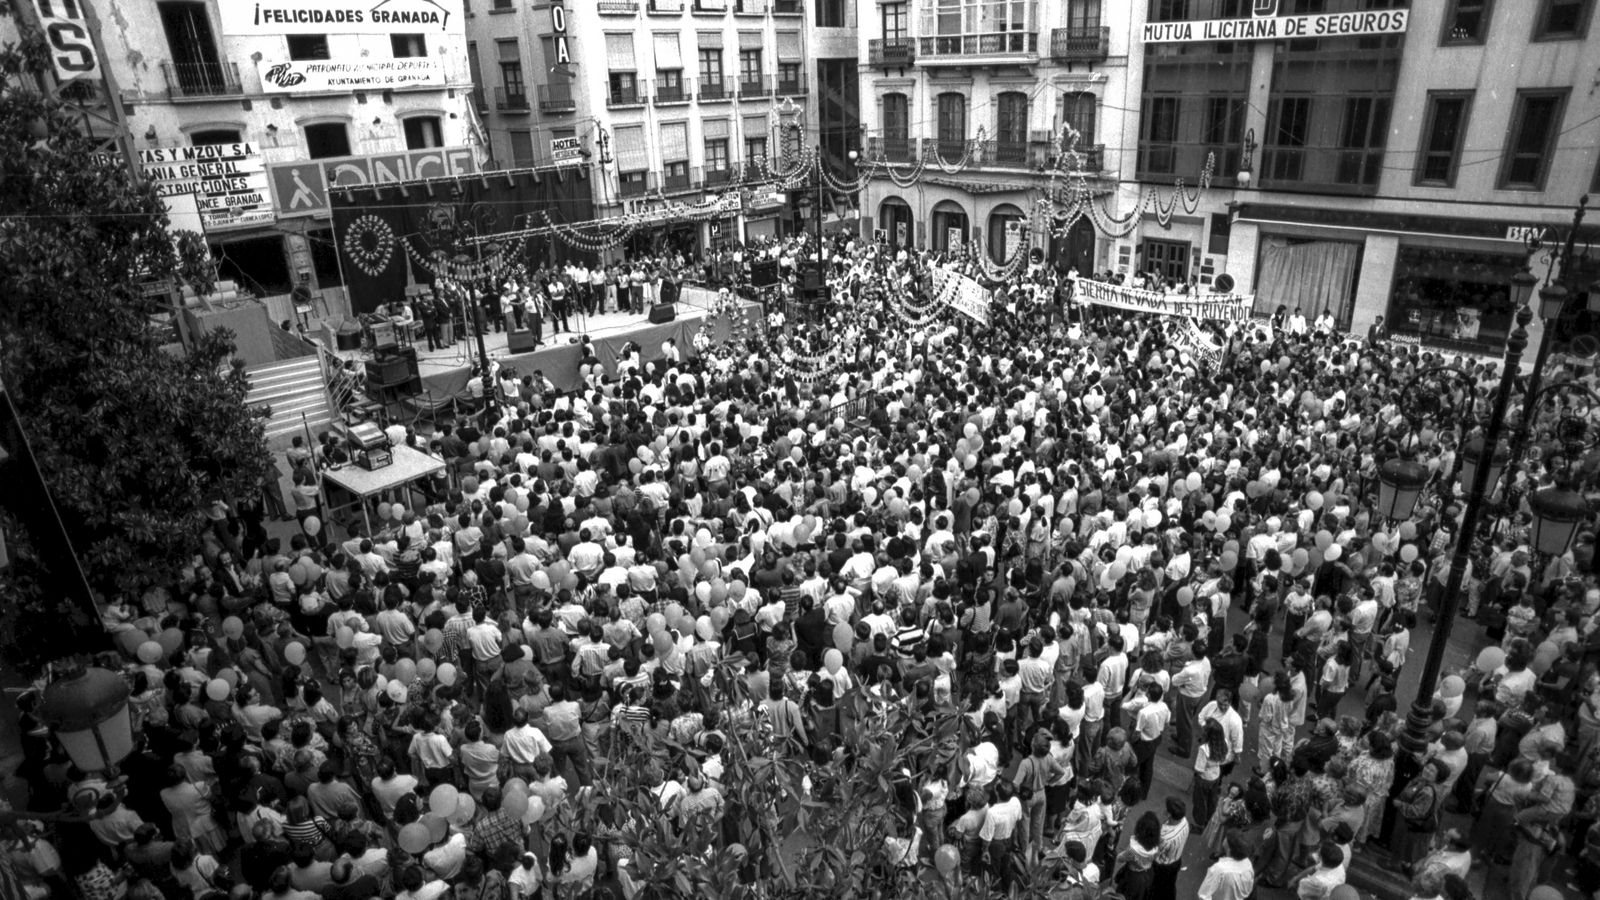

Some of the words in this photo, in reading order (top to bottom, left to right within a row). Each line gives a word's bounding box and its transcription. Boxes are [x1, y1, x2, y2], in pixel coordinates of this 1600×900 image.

[371, 10, 450, 31] GRANADA!
[1143, 23, 1192, 41] MUTUA
[1203, 19, 1277, 39] ILICITANA
[1284, 17, 1308, 36] DE
[1314, 11, 1404, 35] SEGUROS
[306, 62, 351, 74] PATRONATO
[327, 75, 381, 86] AYUNTAMIENTO
[384, 75, 394, 84] DE
[398, 74, 430, 83] GRANADA
[168, 148, 177, 161] Y
[233, 143, 256, 156] S.A.
[553, 138, 581, 150] HOTEL
[180, 161, 241, 177] GENERAL
[332, 151, 471, 188] ONCE
[225, 193, 264, 207] GRANADA
[1078, 280, 1119, 302] SIERRA
[1120, 288, 1168, 311] NEVADA
[1174, 301, 1251, 323] DESTRUYENDO
